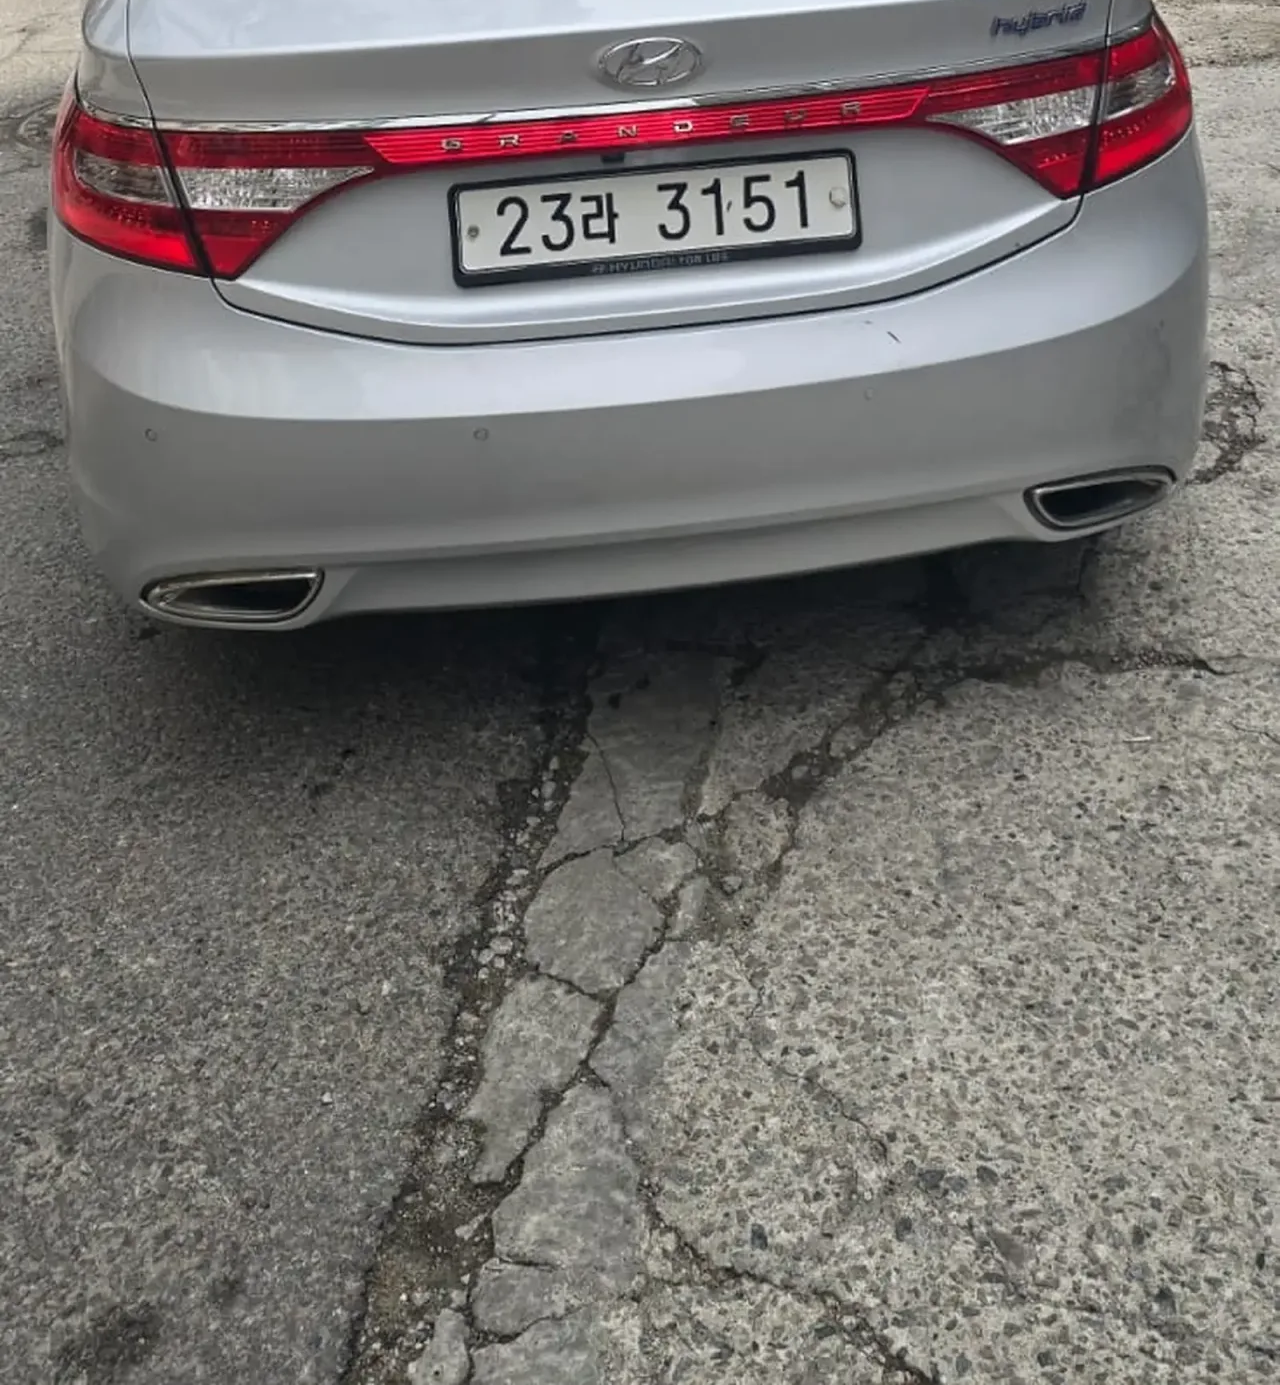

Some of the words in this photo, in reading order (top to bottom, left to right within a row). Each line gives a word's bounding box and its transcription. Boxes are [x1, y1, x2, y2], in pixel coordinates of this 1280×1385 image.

[440, 101, 861, 152] GRANDEUR
[496, 192, 619, 257] 23라
[656, 169, 810, 241] 3151
